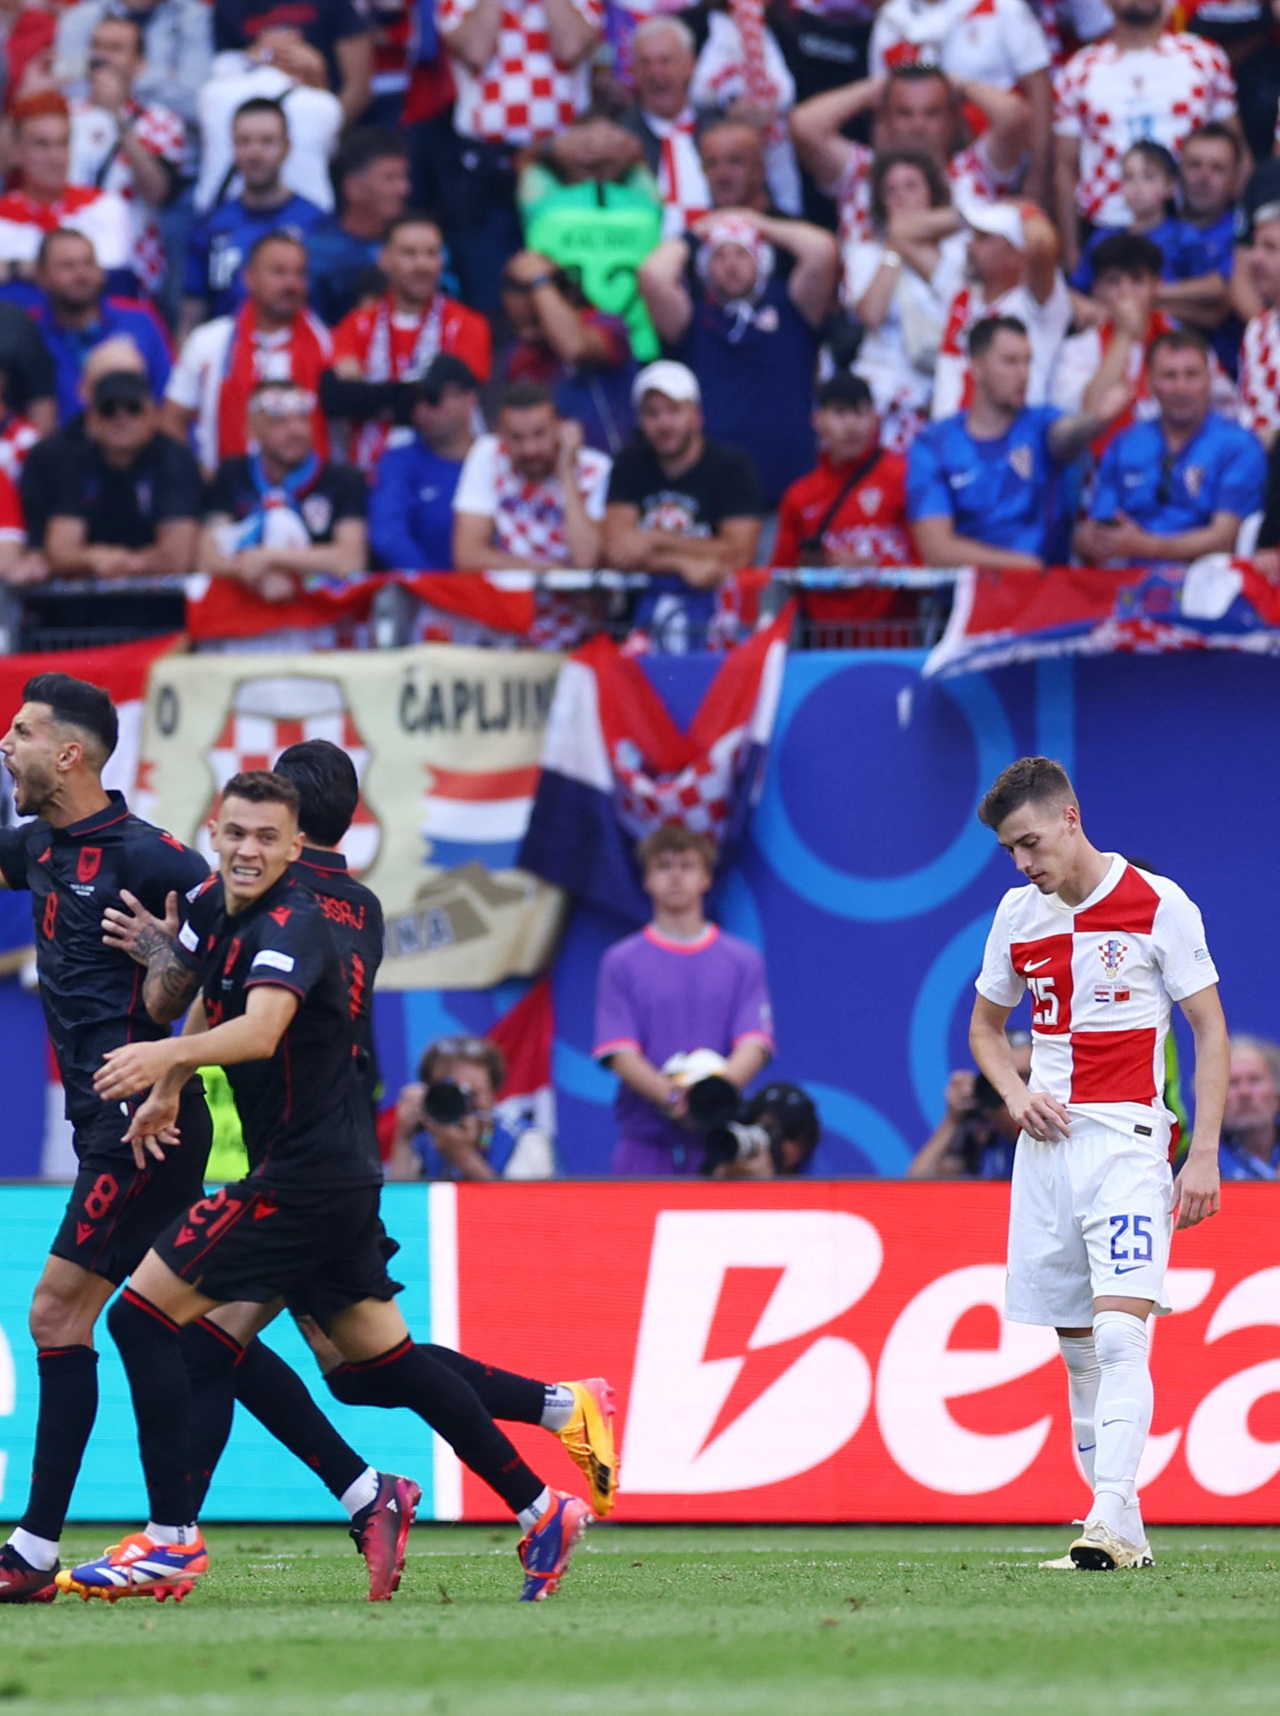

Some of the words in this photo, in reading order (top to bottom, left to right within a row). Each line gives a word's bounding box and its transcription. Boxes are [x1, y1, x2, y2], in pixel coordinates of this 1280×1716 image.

[1026, 977, 1059, 1026] 25
[84, 1173, 119, 1219] 8
[1110, 1214, 1152, 1261] 25
